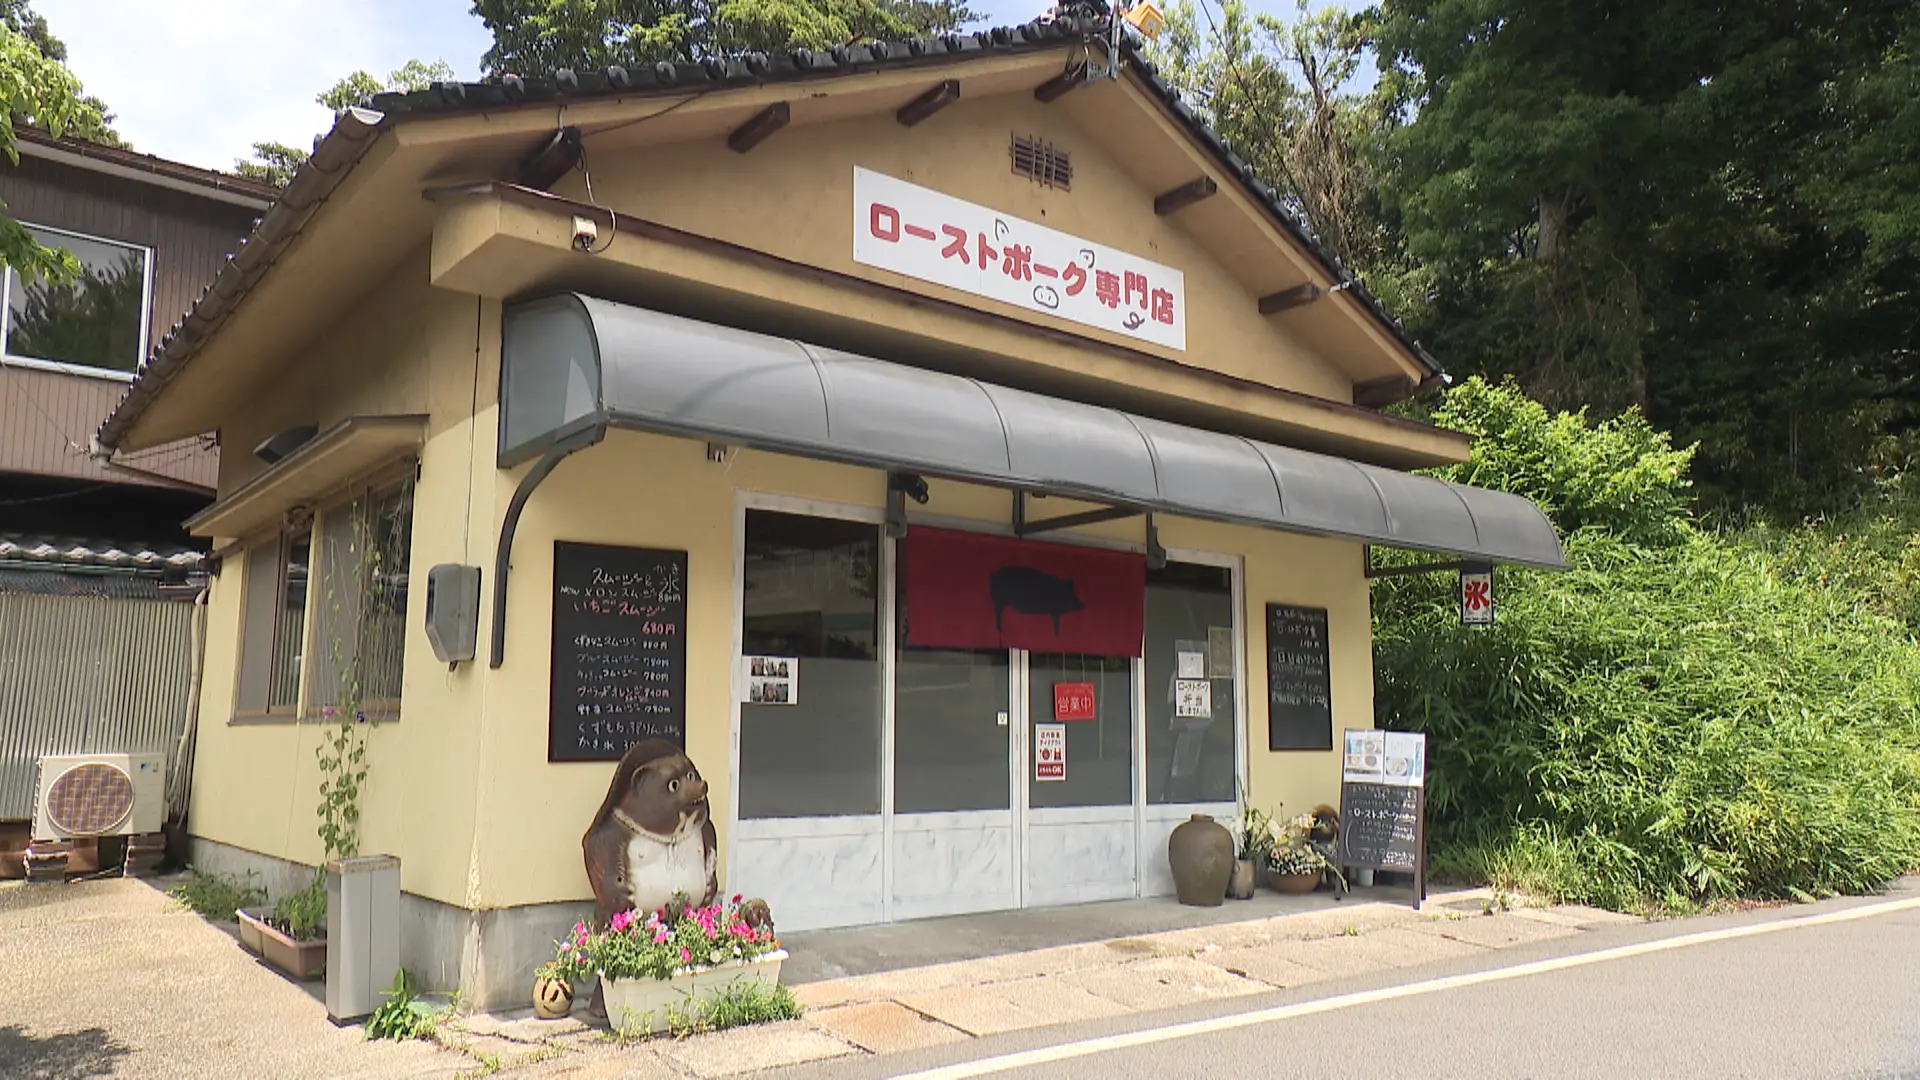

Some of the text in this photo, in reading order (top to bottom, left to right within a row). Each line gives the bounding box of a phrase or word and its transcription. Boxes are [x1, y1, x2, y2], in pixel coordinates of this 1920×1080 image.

[870, 203, 1174, 325] ローストポーク専門店
[1465, 581, 1490, 610] 氷
[642, 621, 676, 635] 680円
[1058, 695, 1091, 713] 営業中
